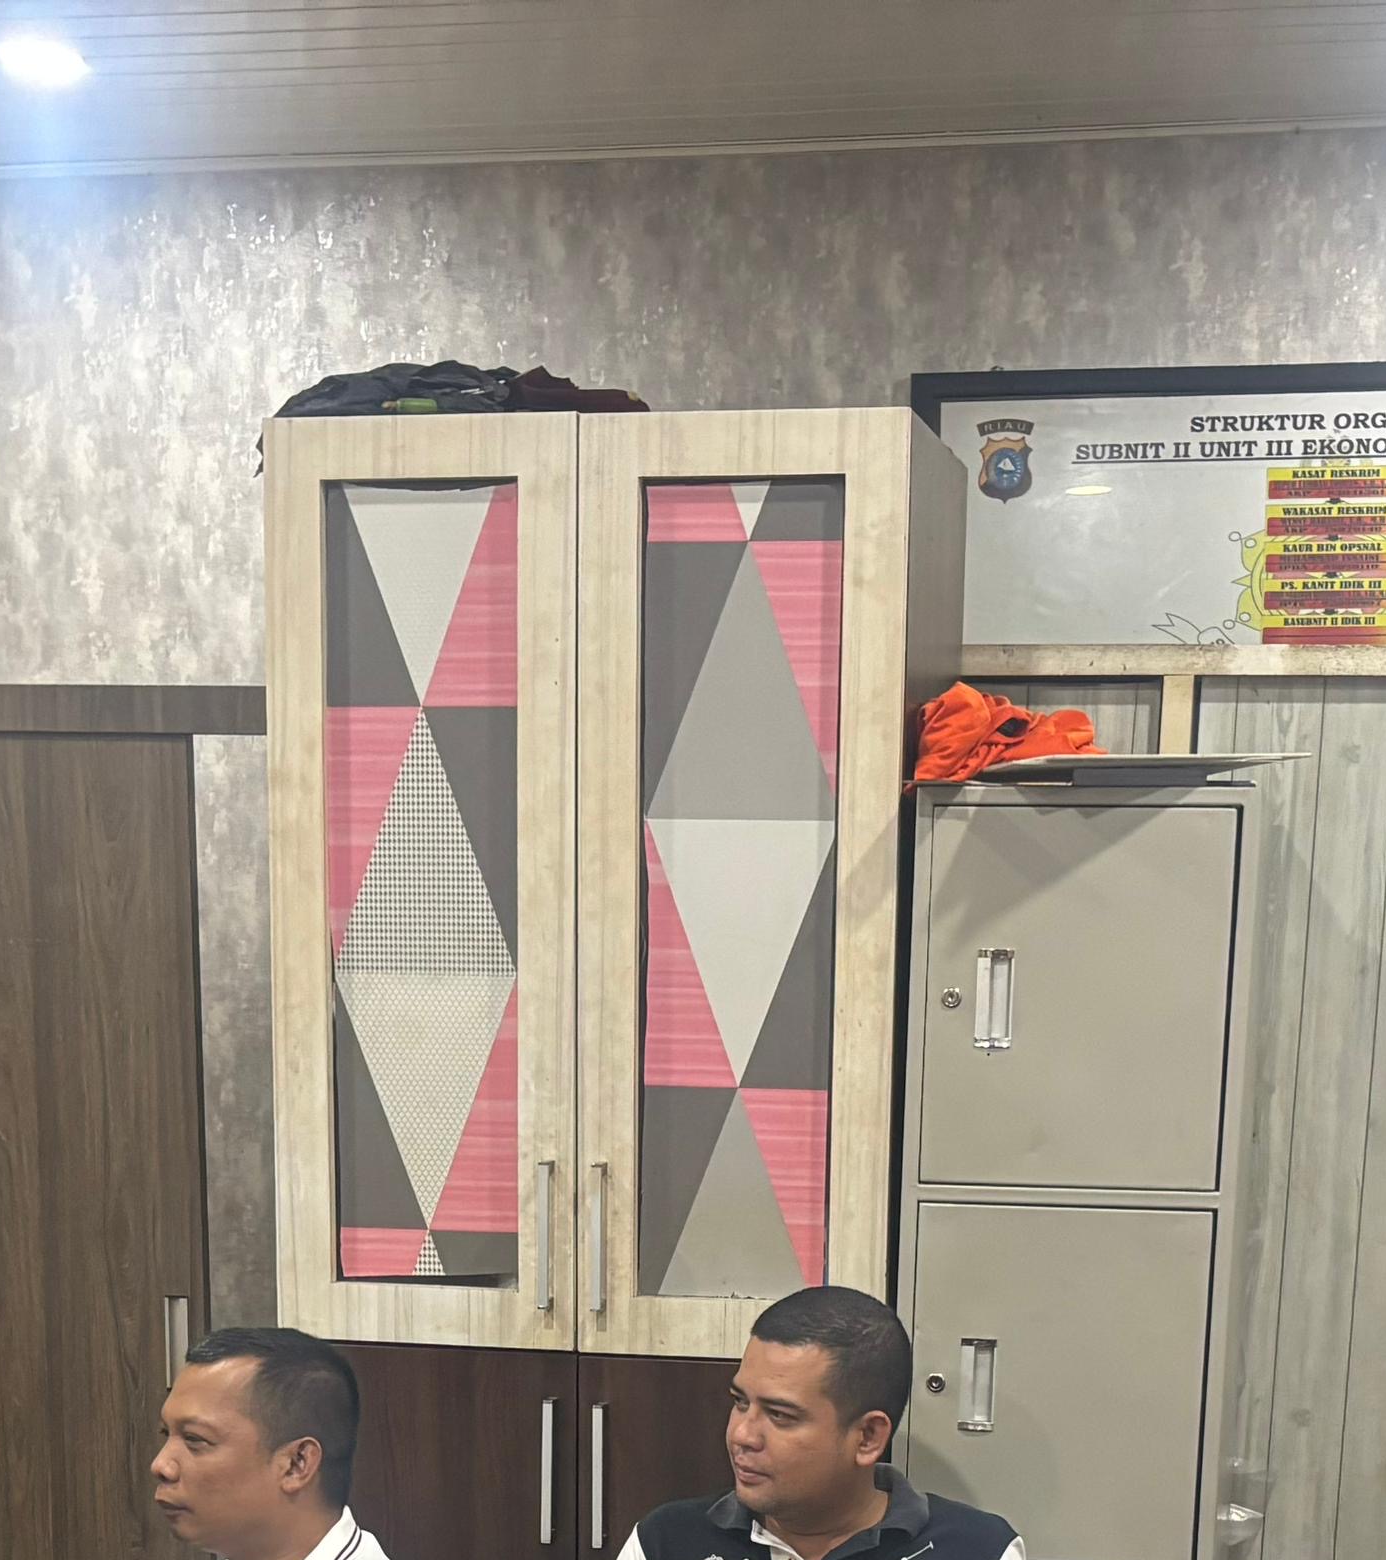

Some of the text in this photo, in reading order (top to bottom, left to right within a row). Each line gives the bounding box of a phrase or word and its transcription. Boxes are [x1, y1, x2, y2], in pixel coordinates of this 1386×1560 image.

[1190, 413, 1327, 434] STRUKTUR
[1075, 442, 1165, 461] SUBNIT
[1173, 441, 1191, 458] II
[1199, 440, 1258, 458] UNIT
[1265, 439, 1294, 456] III
[1292, 468, 1381, 479] KASAT RESKRIM
[1282, 505, 1386, 516] WAKASAT RESKRIM
[1283, 542, 1383, 553] KAUR BIN OPSNAL
[1281, 579, 1382, 590] PS. KANIT IDIK III
[1341, 616, 1365, 626] IDIK
